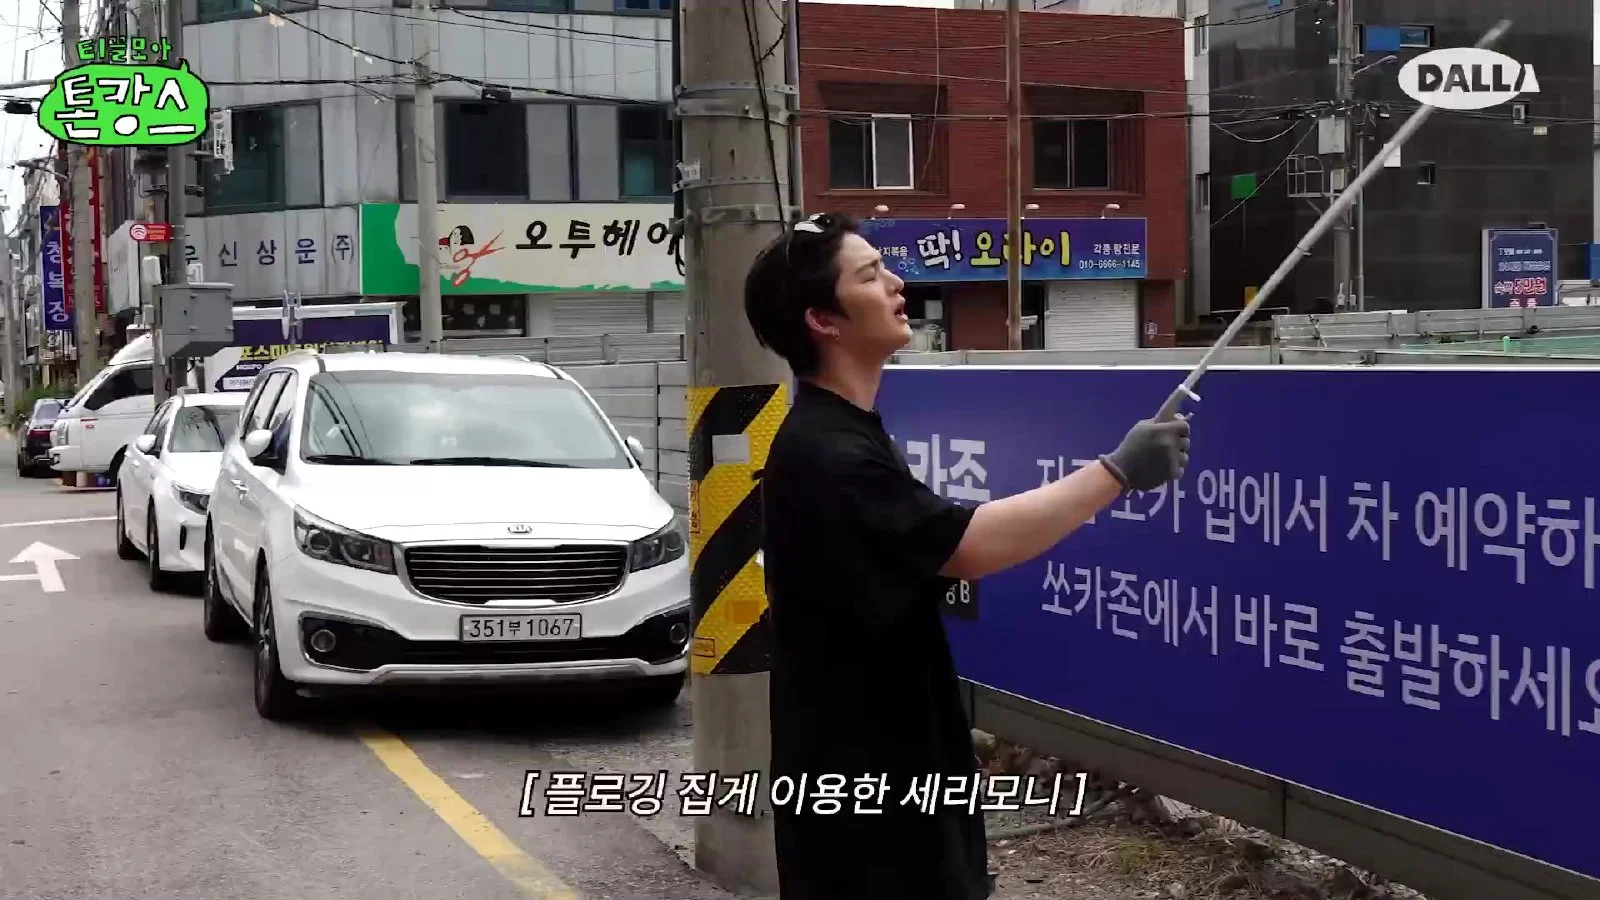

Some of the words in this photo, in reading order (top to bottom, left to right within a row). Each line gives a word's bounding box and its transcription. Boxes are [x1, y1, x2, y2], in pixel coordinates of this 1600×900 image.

[516, 219, 676, 258] 오투헤어
[917, 229, 962, 269] 딱!
[890, 433, 991, 504] 카존
[1197, 468, 1328, 553] 앱에서
[1346, 480, 1399, 561] 차
[1414, 486, 1600, 590] 예약하
[1041, 560, 1218, 656] 쏘카존에서
[1234, 594, 1325, 672] 바로
